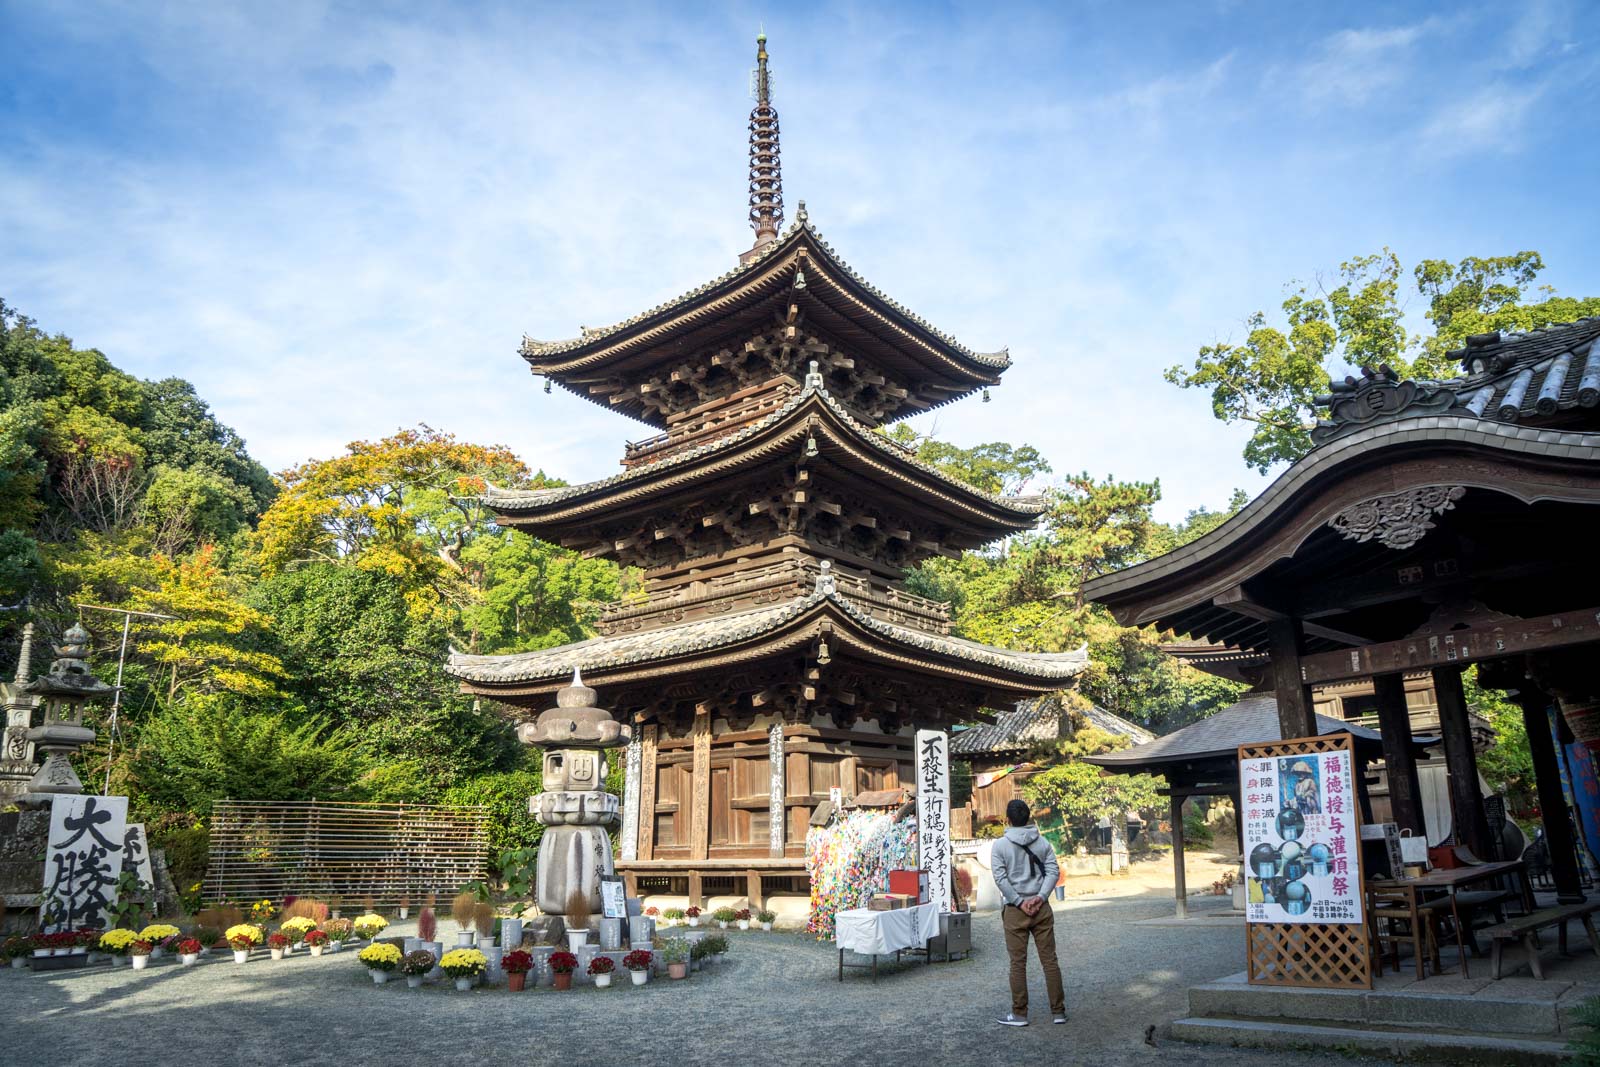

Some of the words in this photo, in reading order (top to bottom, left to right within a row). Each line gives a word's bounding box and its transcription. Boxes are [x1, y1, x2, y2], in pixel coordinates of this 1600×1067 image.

[1246, 763, 1261, 820] 心身安楽
[1259, 761, 1276, 819] 罪障消滅
[1324, 755, 1349, 897] 福徳授与灌頂祭
